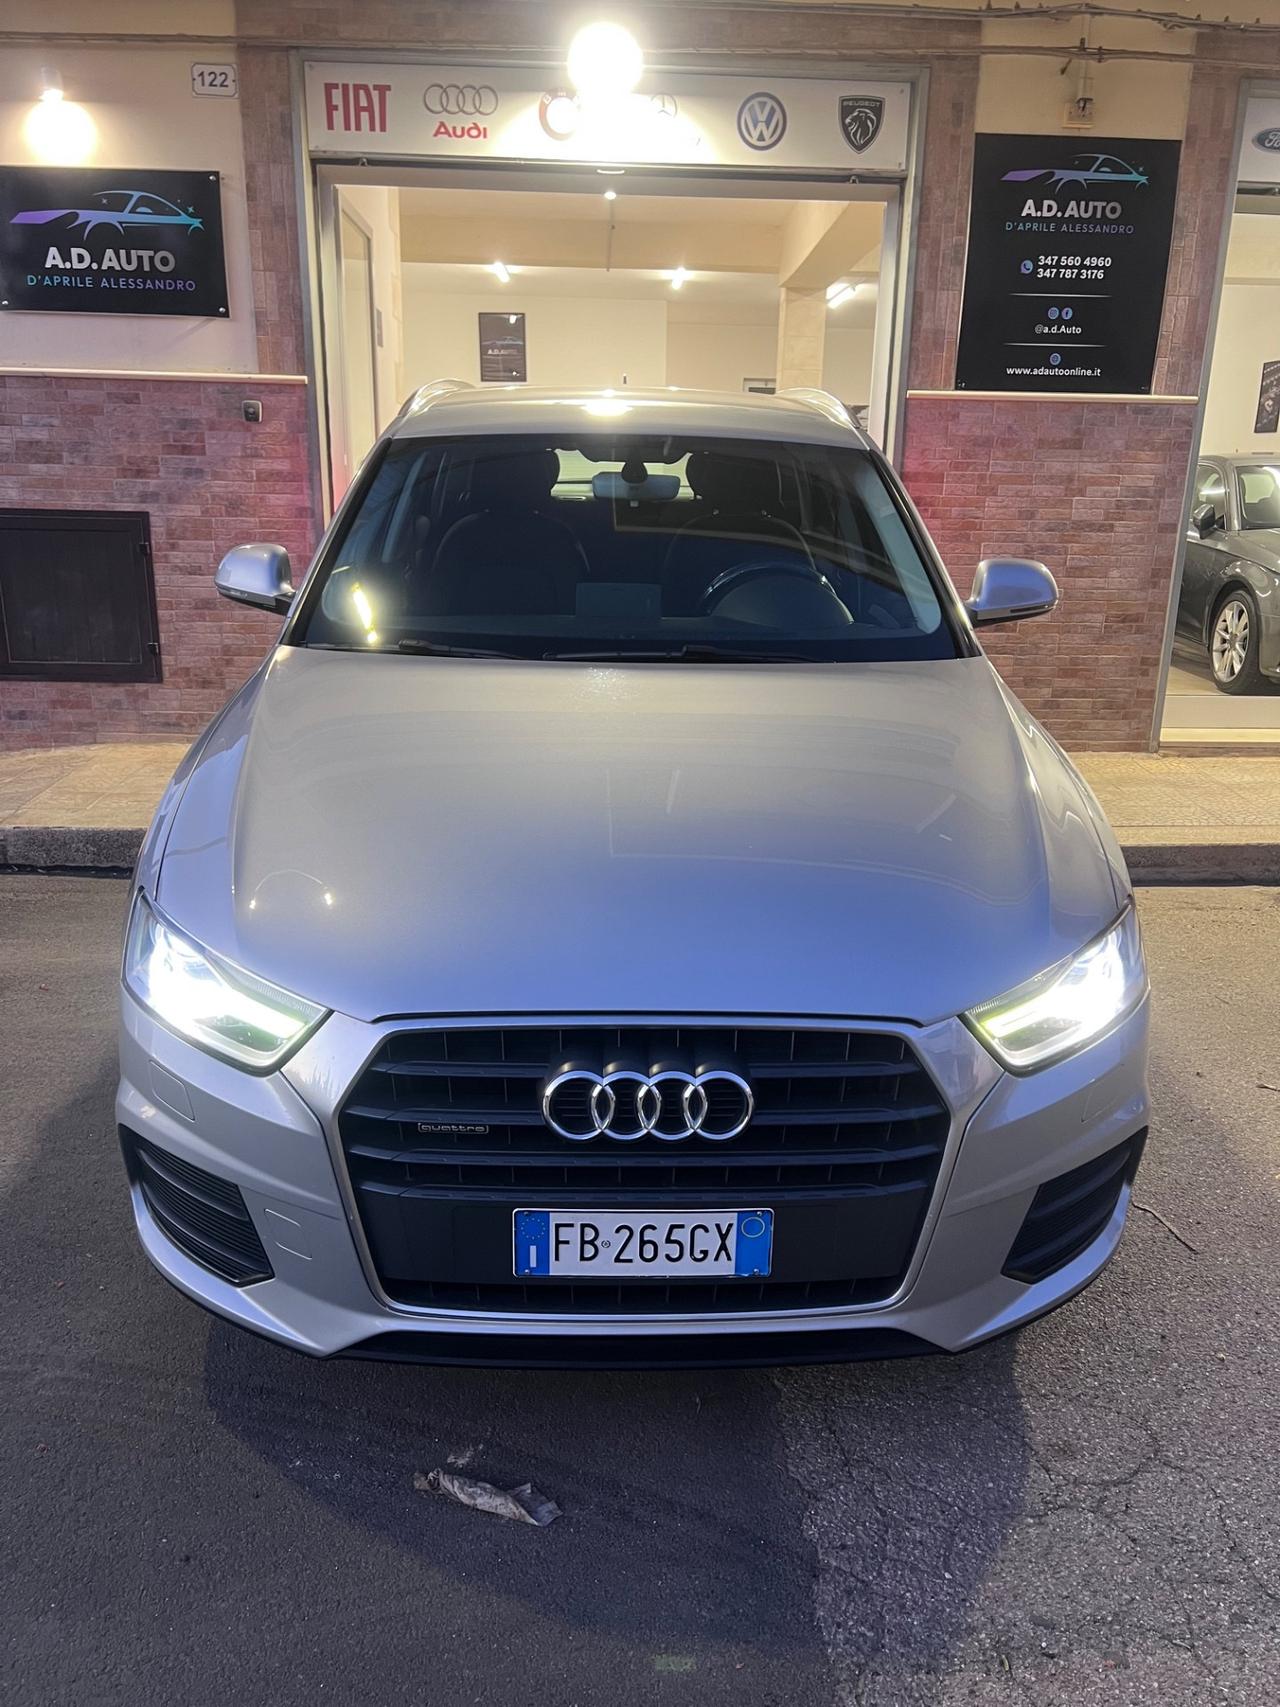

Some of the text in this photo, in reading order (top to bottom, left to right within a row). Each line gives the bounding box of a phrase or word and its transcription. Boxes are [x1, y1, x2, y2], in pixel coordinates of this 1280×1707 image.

[197, 72, 229, 88] 122
[324, 82, 392, 132] FIAT
[432, 121, 488, 139] Audi
[1005, 222, 1134, 234] D'APRILE ALESSANDRO
[1038, 255, 1112, 267] 347 560 4960
[1037, 268, 1104, 280] 347 787 3176
[27, 274, 196, 291] D'APRILE ALESSANDRO
[1035, 323, 1082, 334] @a.d.Auto
[1006, 366, 1101, 377] www.adautoonline.it
[420, 1124, 486, 1133] quattro
[554, 1222, 600, 1263] FB
[614, 1223, 734, 1264] 265GX
